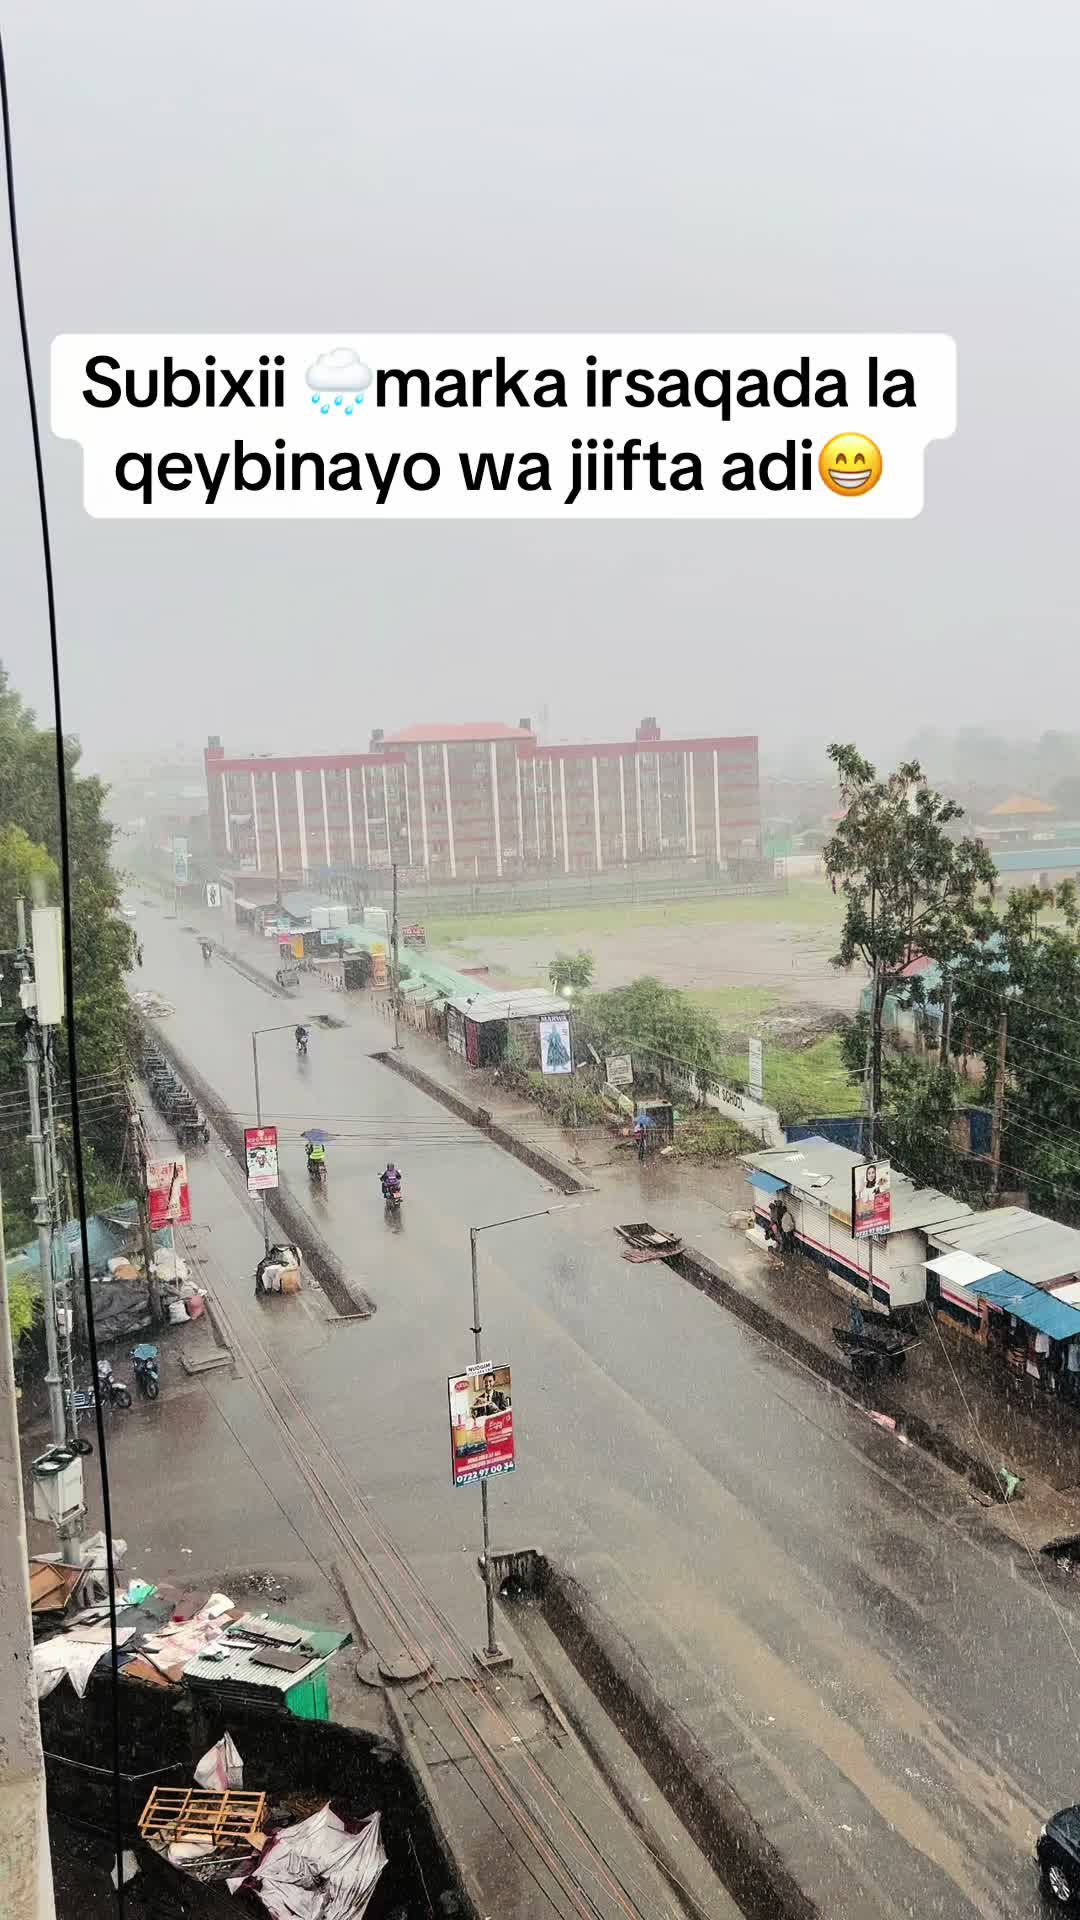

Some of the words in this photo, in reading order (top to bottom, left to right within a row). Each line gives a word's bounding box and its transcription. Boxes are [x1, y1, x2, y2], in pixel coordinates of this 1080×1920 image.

[722, 1087, 745, 1112] SCHOOL
[456, 1470, 478, 1483] 0722
[479, 1467, 489, 1477] 97
[490, 1464, 502, 1473] 00
